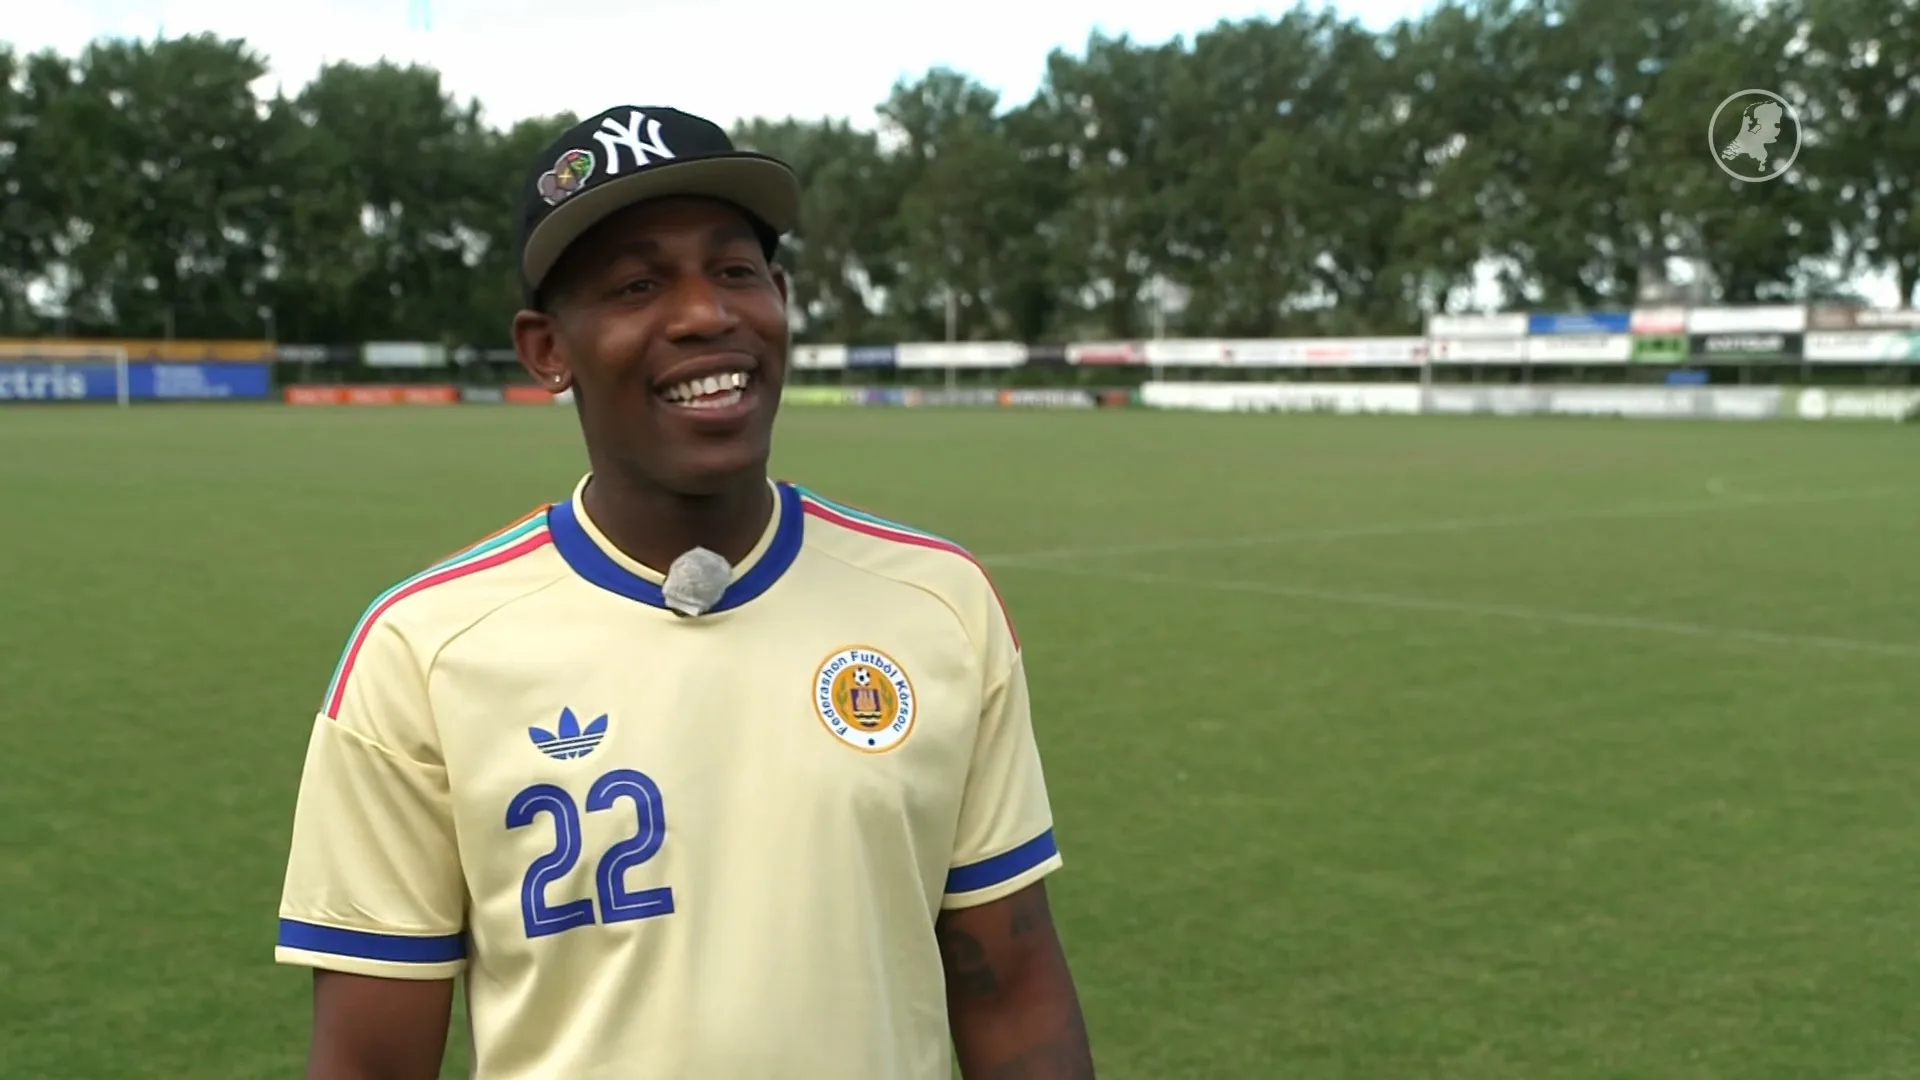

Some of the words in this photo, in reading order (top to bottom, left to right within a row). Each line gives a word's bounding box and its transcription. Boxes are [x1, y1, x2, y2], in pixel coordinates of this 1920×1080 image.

[593, 110, 676, 175] NY
[820, 657, 848, 736] Federashon
[505, 768, 675, 939] 22
